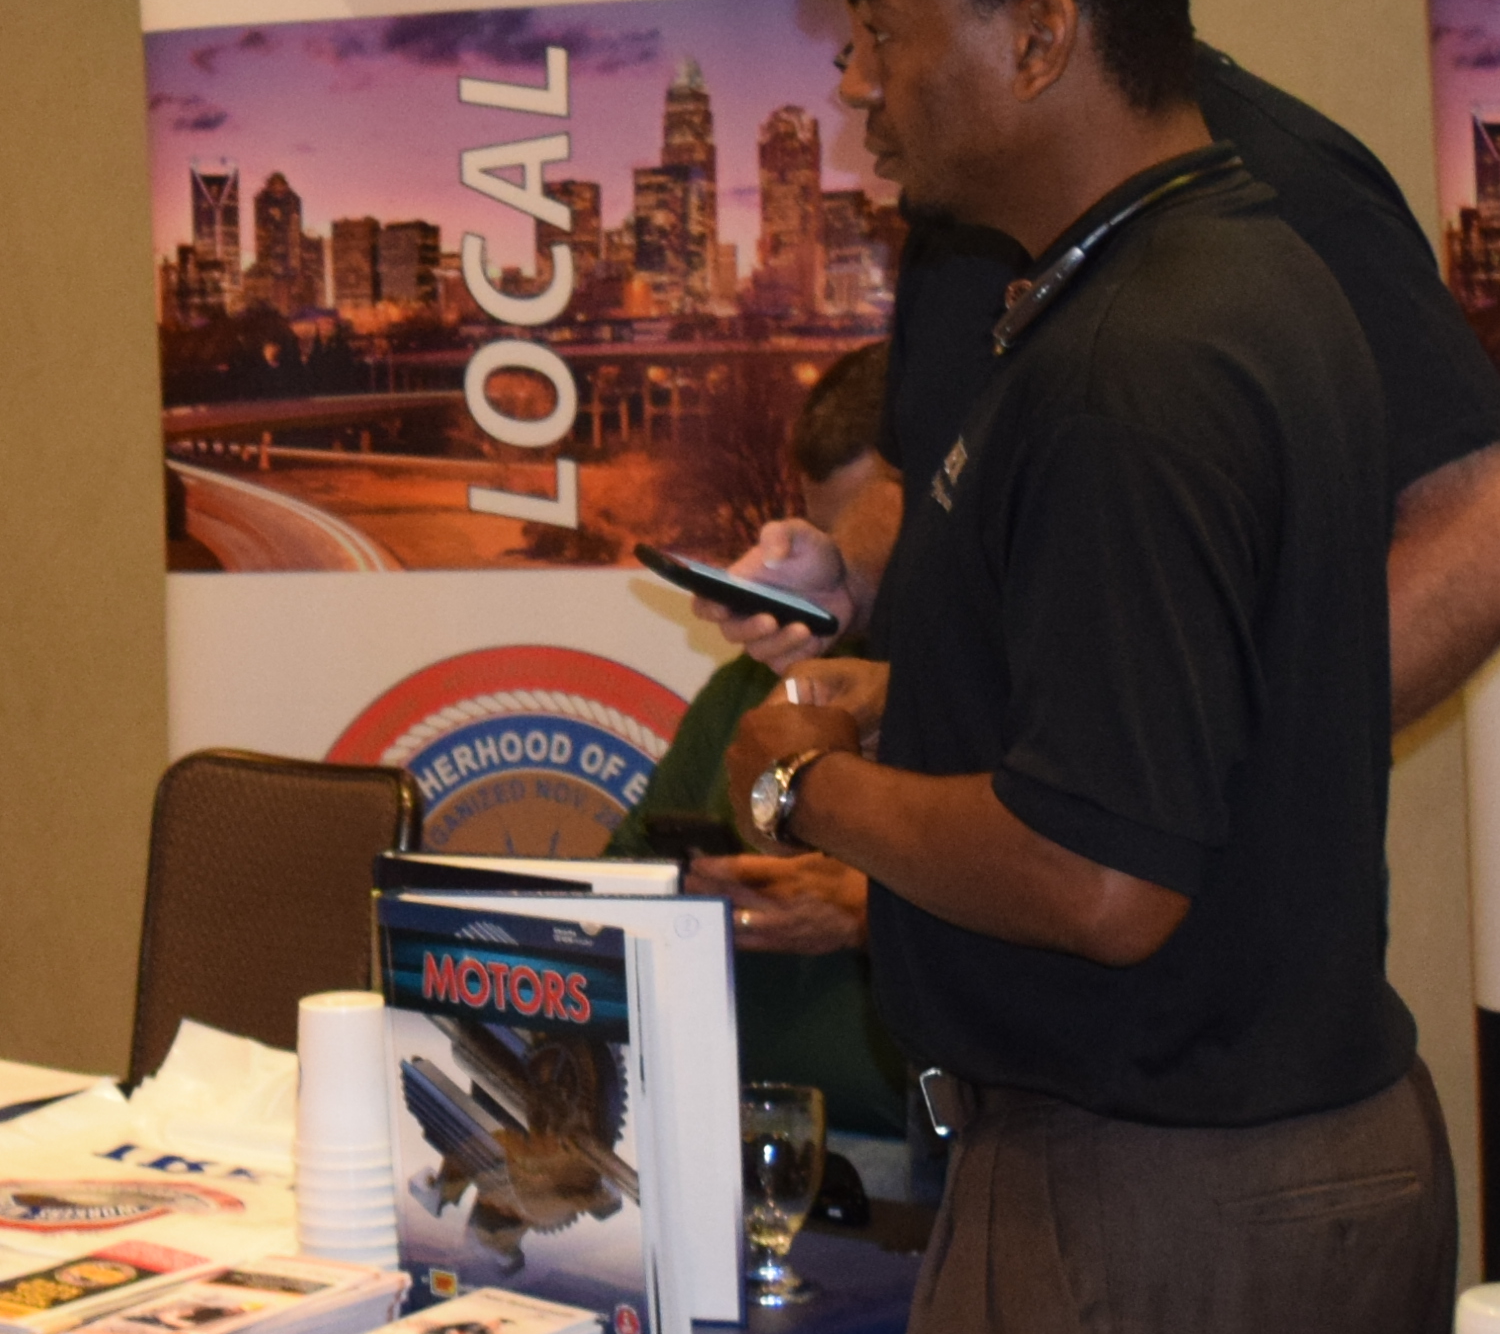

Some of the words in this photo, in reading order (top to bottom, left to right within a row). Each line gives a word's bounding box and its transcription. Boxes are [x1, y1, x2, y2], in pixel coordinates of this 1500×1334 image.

[458, 45, 580, 529] LOCAL
[416, 730, 572, 800] HERHOOD
[580, 744, 626, 781] OF
[422, 951, 592, 1024] MOTORS
